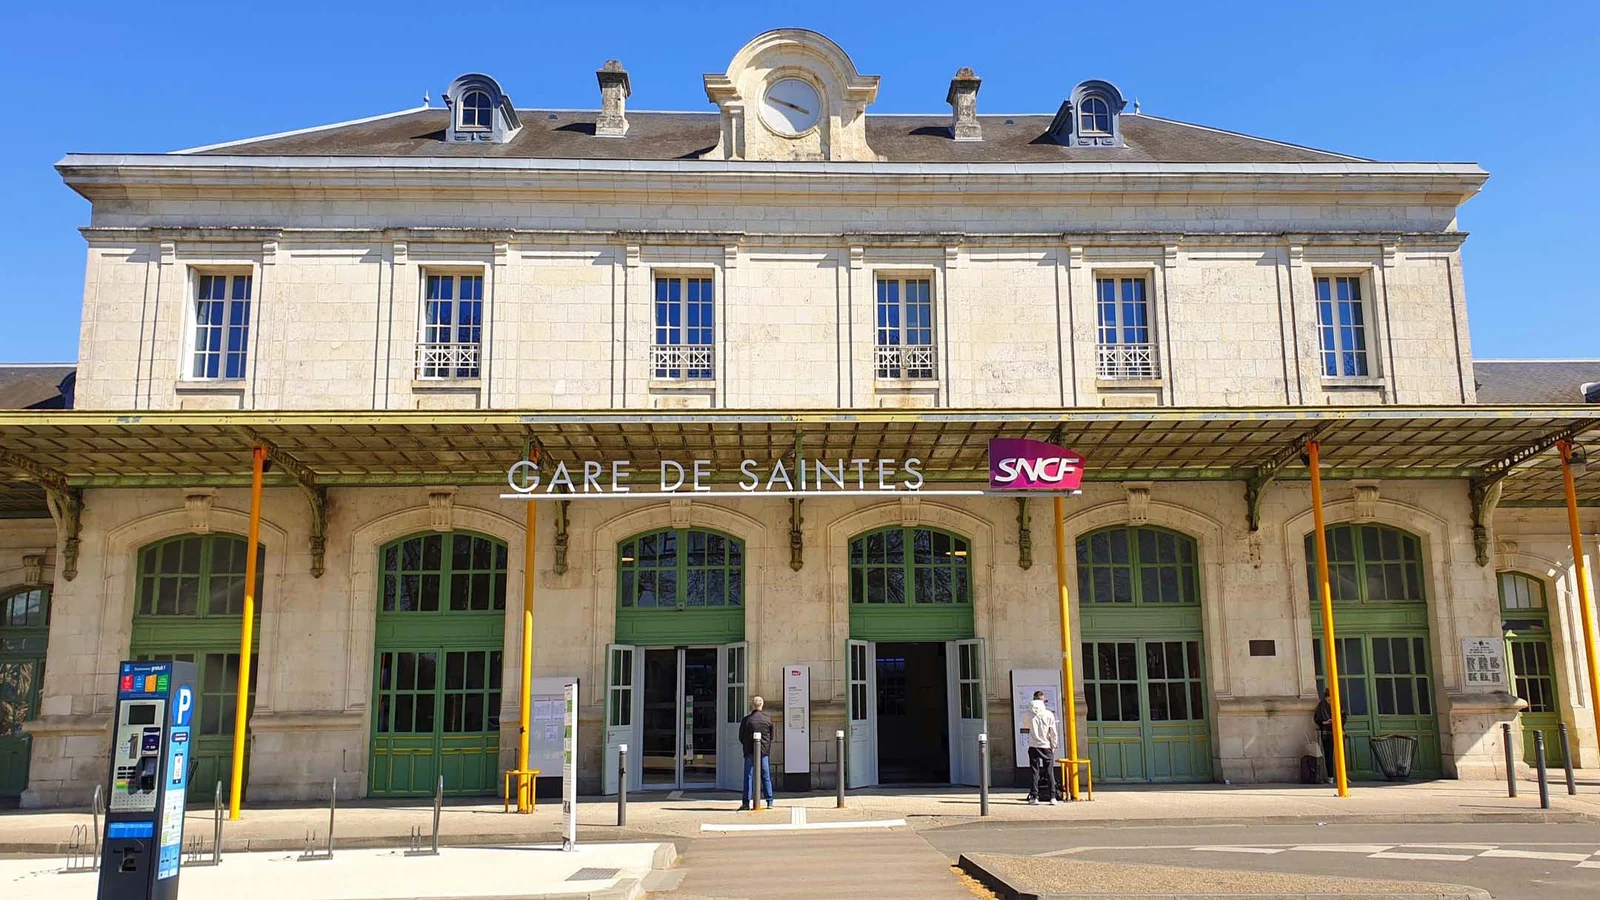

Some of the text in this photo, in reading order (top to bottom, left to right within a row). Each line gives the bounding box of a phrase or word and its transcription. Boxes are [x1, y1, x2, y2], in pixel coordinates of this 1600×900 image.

[507, 458, 924, 493] GARE DE SAINTES
[994, 457, 1079, 483] SNCF
[177, 688, 191, 725] P
